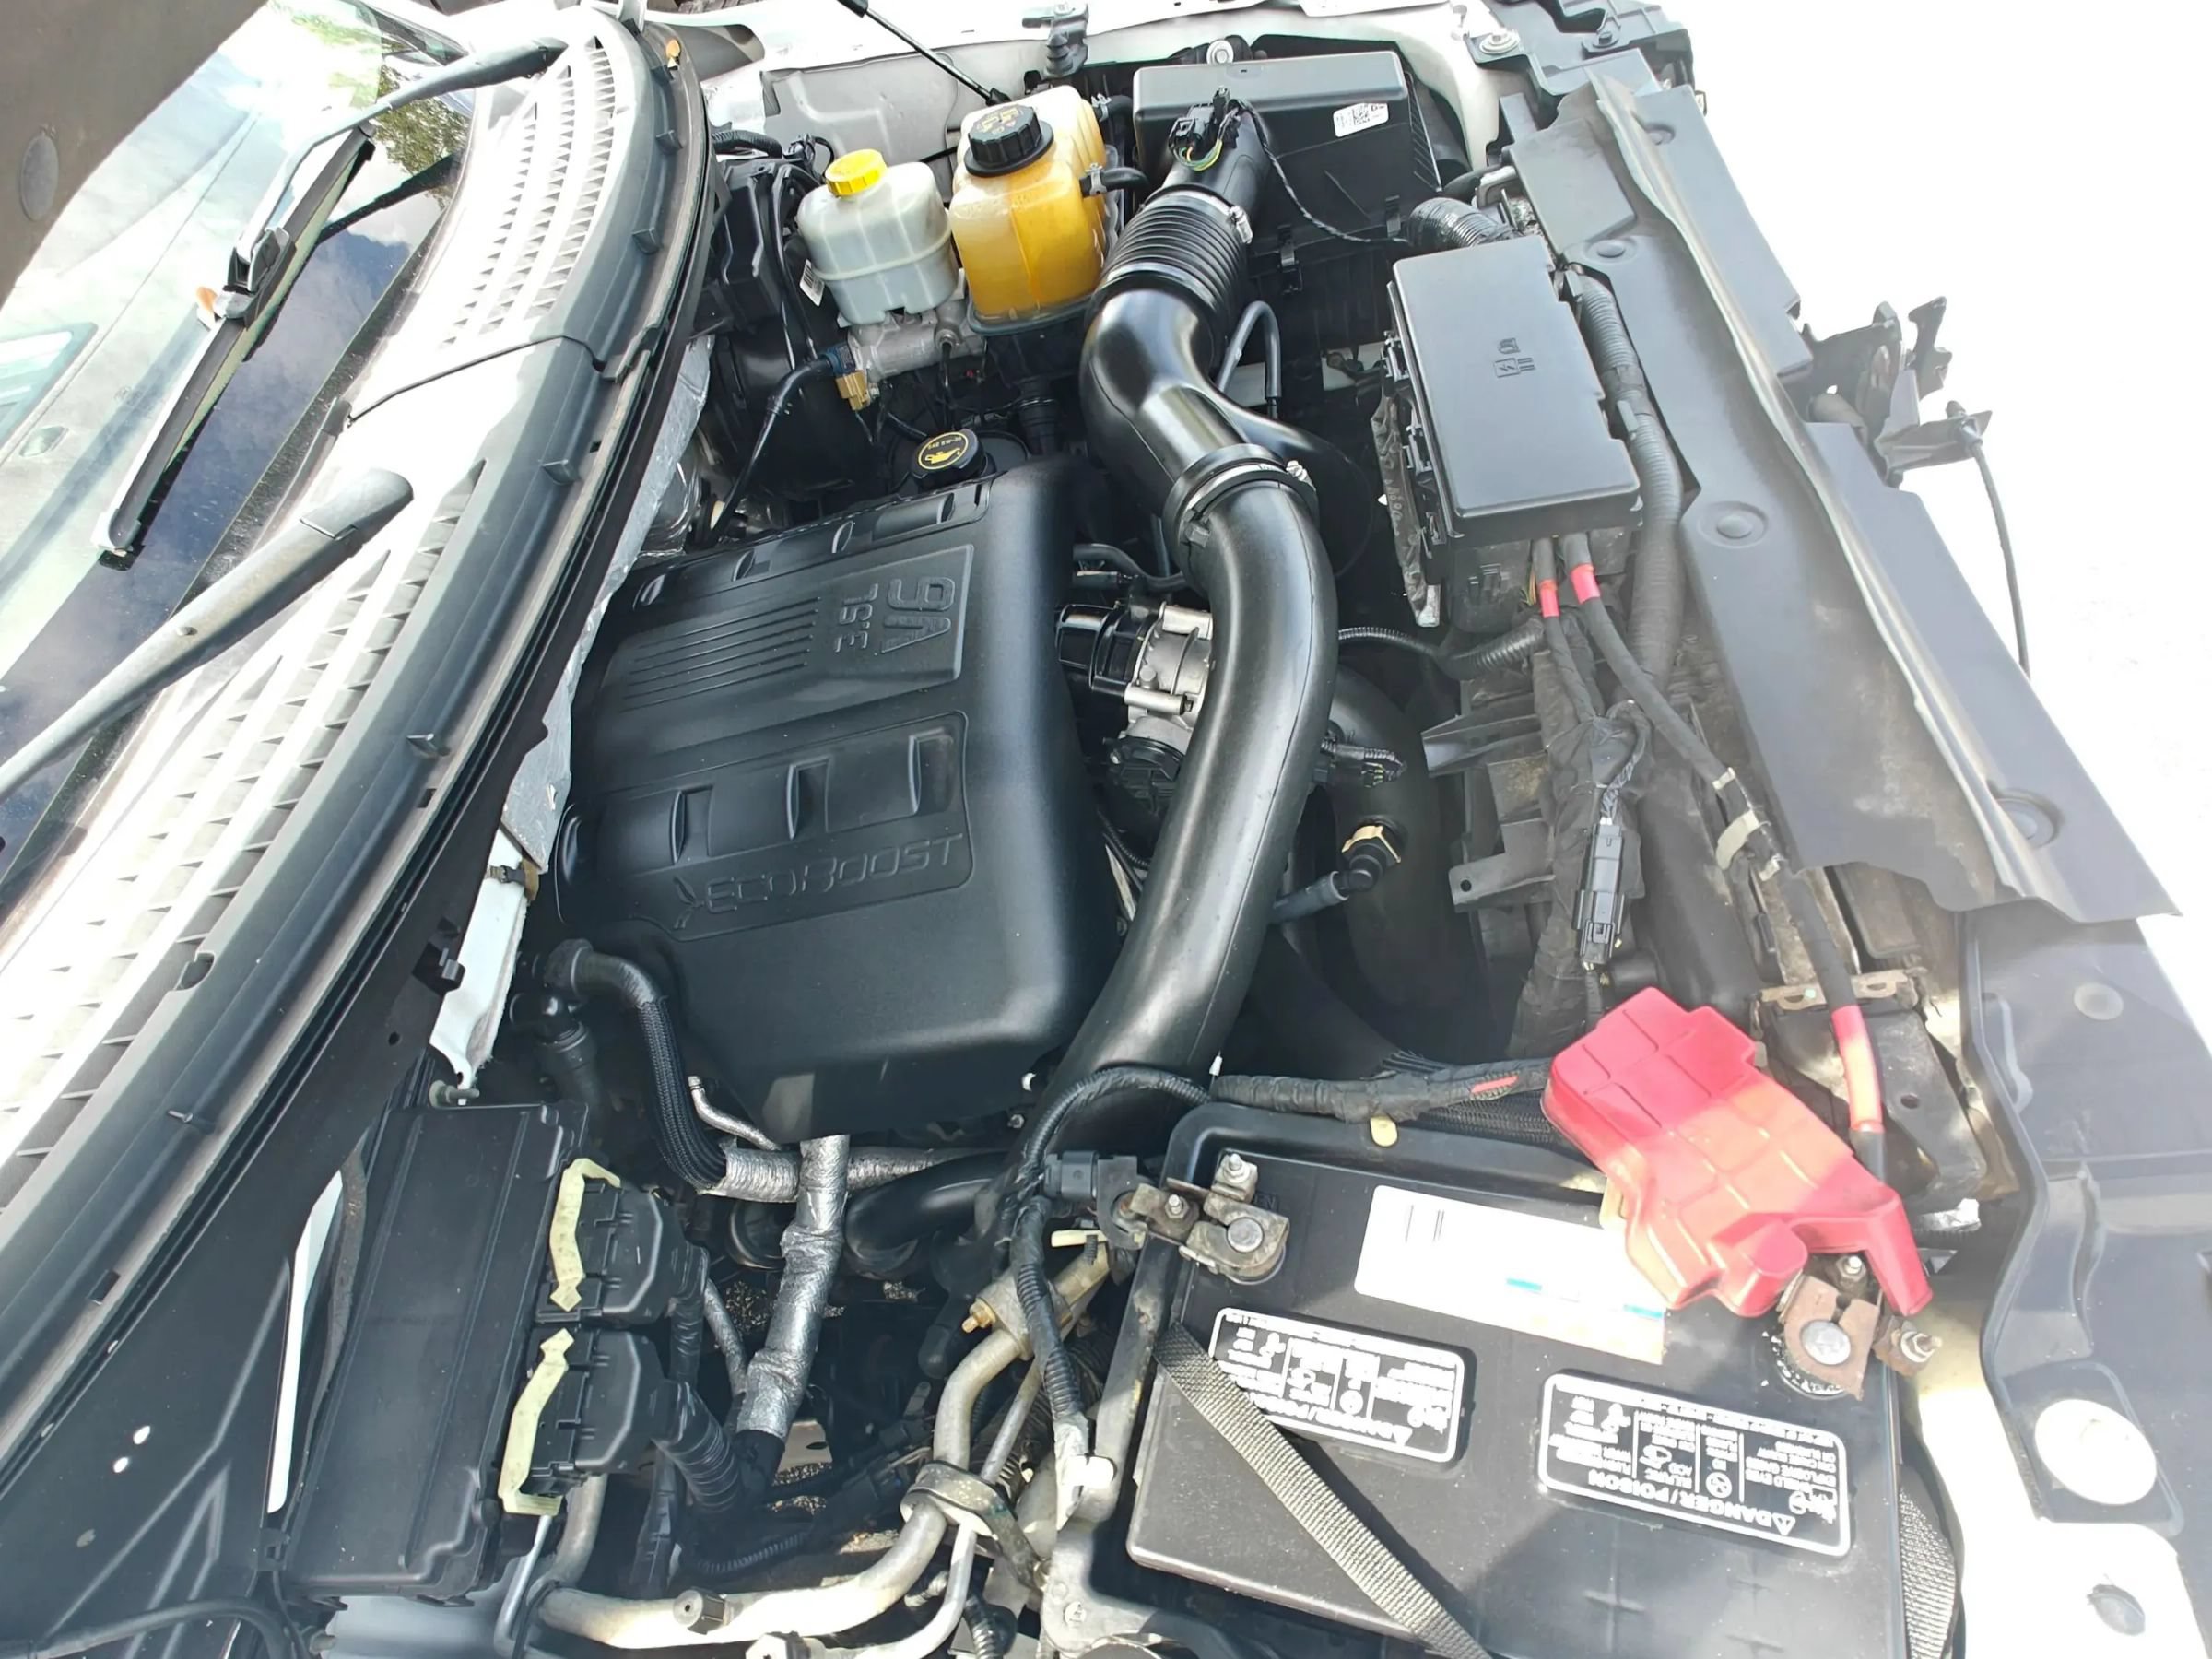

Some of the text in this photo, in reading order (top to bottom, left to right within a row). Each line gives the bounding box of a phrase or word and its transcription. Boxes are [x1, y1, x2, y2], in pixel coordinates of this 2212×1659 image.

[834, 582, 879, 653] 3.5L
[881, 576, 956, 654] V6
[707, 832, 963, 914] ECOBOOST
[1588, 1469, 1670, 1502] POISON
[1680, 1492, 1773, 1528] DANGER
